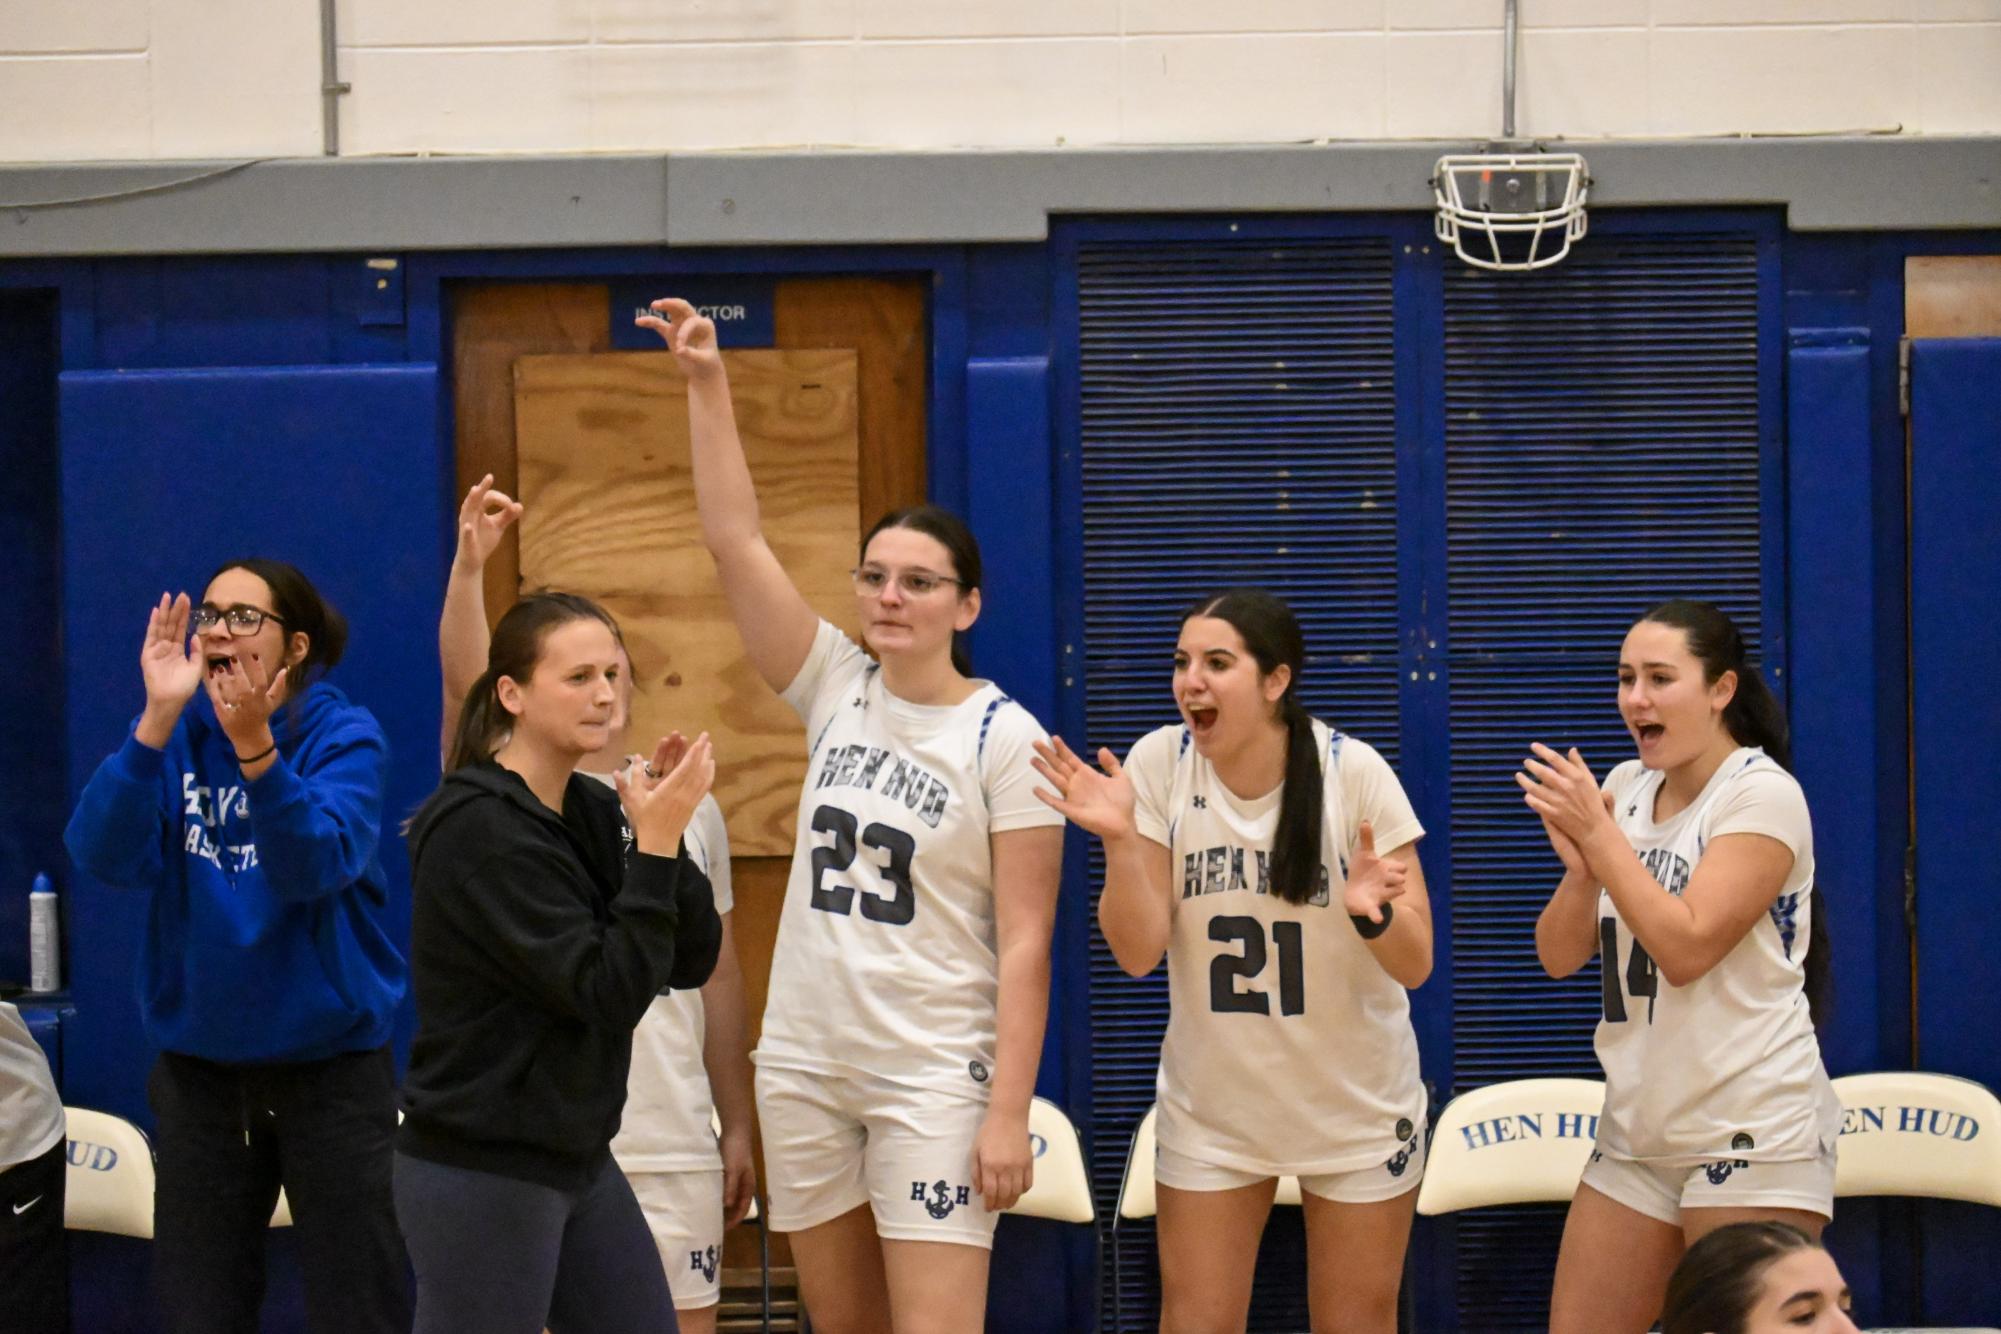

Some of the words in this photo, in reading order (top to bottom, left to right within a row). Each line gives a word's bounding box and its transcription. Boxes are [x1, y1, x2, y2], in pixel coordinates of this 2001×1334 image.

[815, 744, 890, 790] HEN
[880, 752, 949, 829] HUD
[811, 804, 915, 926] 23
[1182, 843, 1249, 899] HEN
[1208, 915, 1305, 1017] 21
[1456, 1113, 1544, 1151] HEN
[1898, 1105, 1980, 1142] HUD
